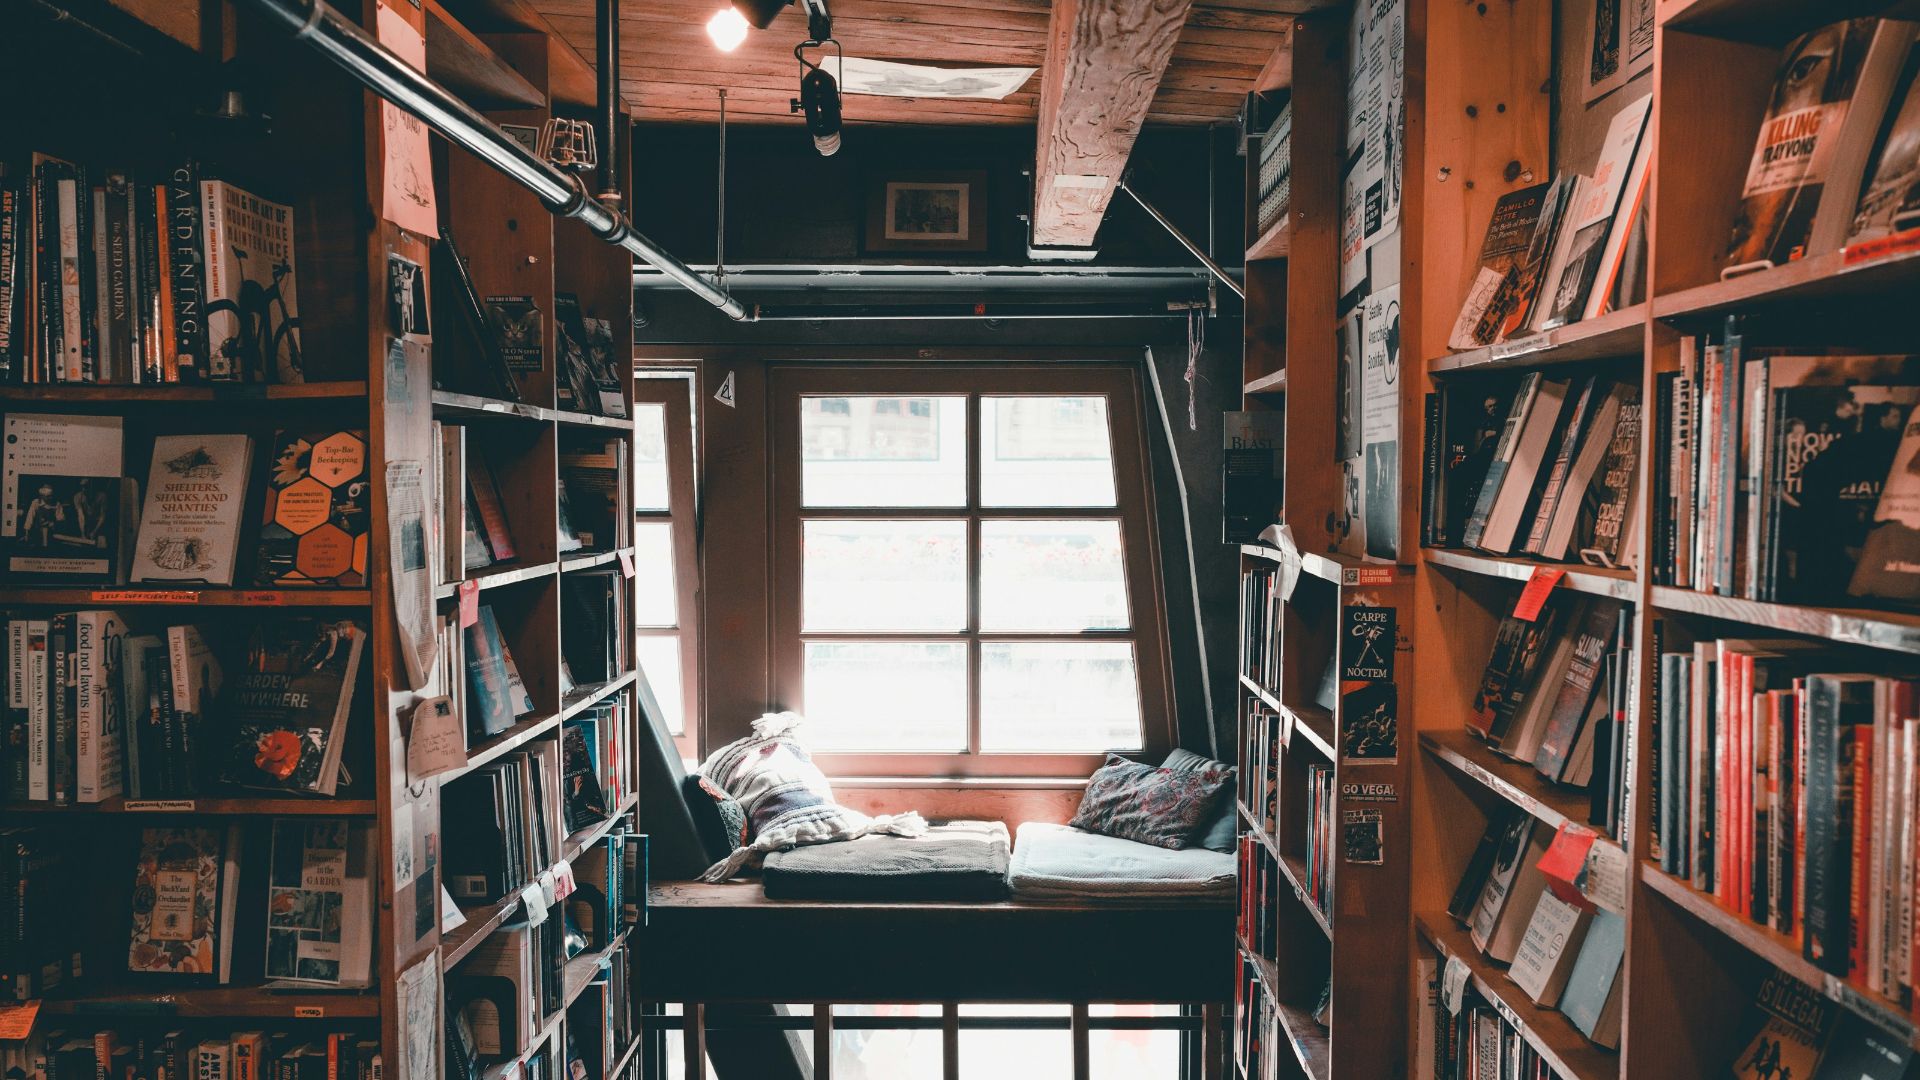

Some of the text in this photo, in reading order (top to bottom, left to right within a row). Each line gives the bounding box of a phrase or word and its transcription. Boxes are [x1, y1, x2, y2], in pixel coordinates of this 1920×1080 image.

[1766, 110, 1824, 146] KILLING
[1761, 136, 1818, 164] TRAYVONS
[1496, 198, 1536, 215] CAMILLO
[1493, 211, 1518, 224] SITTE
[113, 236, 123, 268] SEED
[173, 168, 198, 335] GARDENING
[0, 191, 12, 349] ASK THE FAMILY HANDYMAN
[114, 270, 125, 320] GARDEN
[1679, 379, 1690, 450] DEFIANT
[1231, 437, 1272, 449] BLAST
[317, 456, 359, 465] Beekeeping
[201, 493, 229, 503] AND
[160, 503, 218, 513] SHANTIES
[1368, 569, 1389, 577] CHANGE
[1353, 612, 1388, 623] CARPE
[80, 623, 93, 649] food
[173, 635, 181, 653] This
[80, 652, 90, 672] not
[175, 654, 185, 684] Organic
[1347, 667, 1388, 678] NOCTEM
[55, 651, 64, 745] DECKSCAPING
[80, 673, 93, 708] lawns
[1342, 784, 1359, 794] GO
[171, 875, 183, 884] The
[306, 876, 342, 887] GARDEN
[1758, 979, 1775, 1002] IS
[1771, 986, 1826, 1033] ILLEGAL
